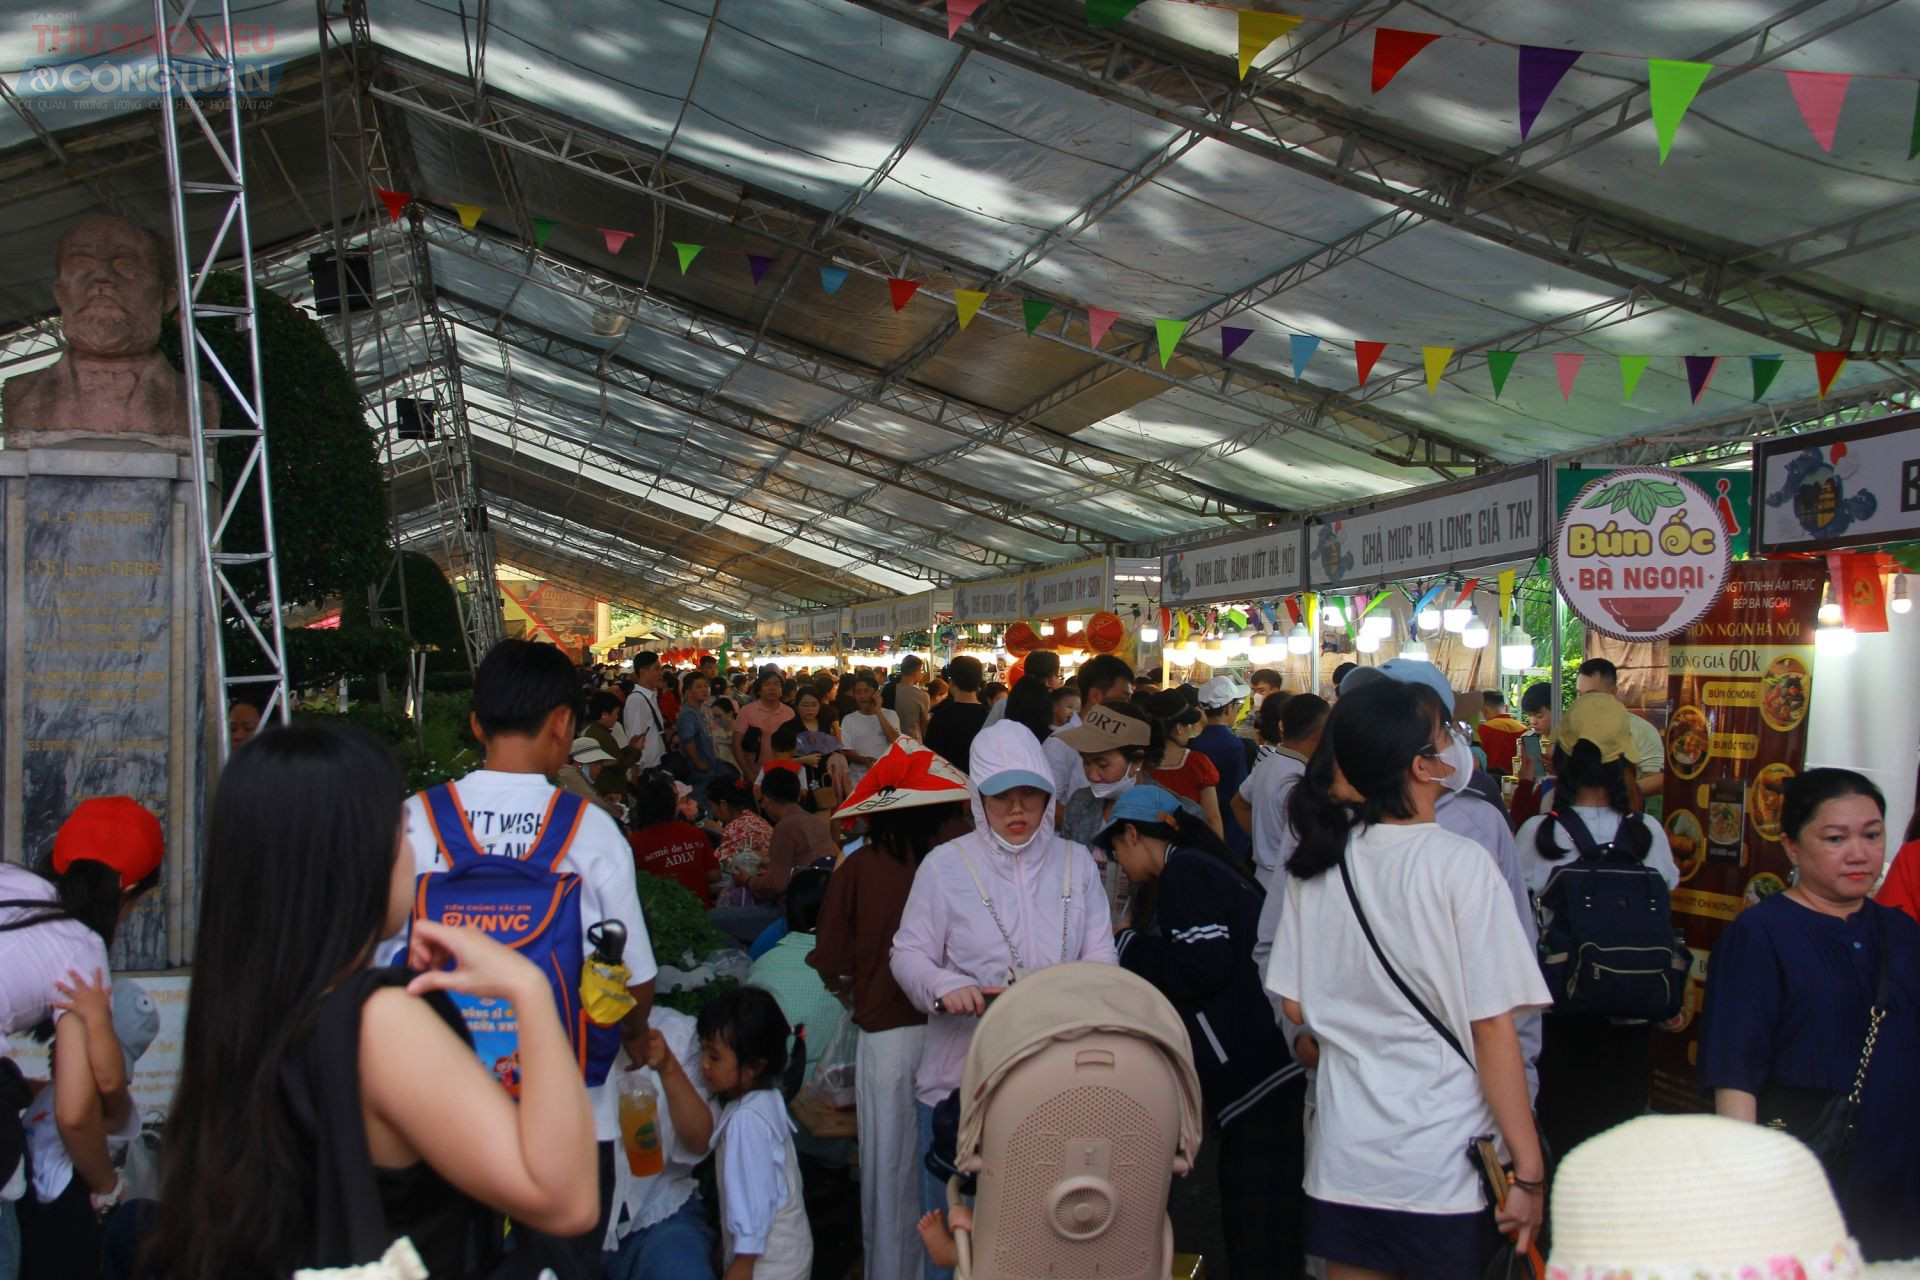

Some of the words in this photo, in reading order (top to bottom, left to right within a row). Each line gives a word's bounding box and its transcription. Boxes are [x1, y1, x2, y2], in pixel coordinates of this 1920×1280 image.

[1362, 526, 1384, 566] CHẢ
[1388, 524, 1413, 564] MỰC
[1418, 521, 1434, 559] HẠ
[1440, 512, 1472, 552] LONG
[1478, 502, 1501, 546] GIÃ
[1506, 499, 1533, 540] TAY
[110, 560, 165, 577] PIERRE
[1195, 558, 1212, 587] BÁNH
[1231, 552, 1249, 582] BÁNH
[1269, 546, 1280, 576] HÀ
[1282, 543, 1296, 578] NỘI
[1579, 559, 1613, 591] BÀ
[1623, 566, 1704, 594] NGOẠI
[1738, 582, 1749, 592] TY
[1749, 581, 1773, 592] TNHH
[1749, 596, 1761, 608] BÀ
[1762, 597, 1791, 611] NGOẠI
[1717, 622, 1755, 638] NGON
[1756, 618, 1773, 637] HÀ
[1776, 619, 1800, 639] NỘI
[1703, 651, 1725, 669] GIÁ
[1729, 649, 1761, 672] 60k
[672, 844, 682, 853] de
[683, 841, 694, 850] la
[665, 851, 695, 868] ADLV
[464, 914, 530, 932] VNVC
